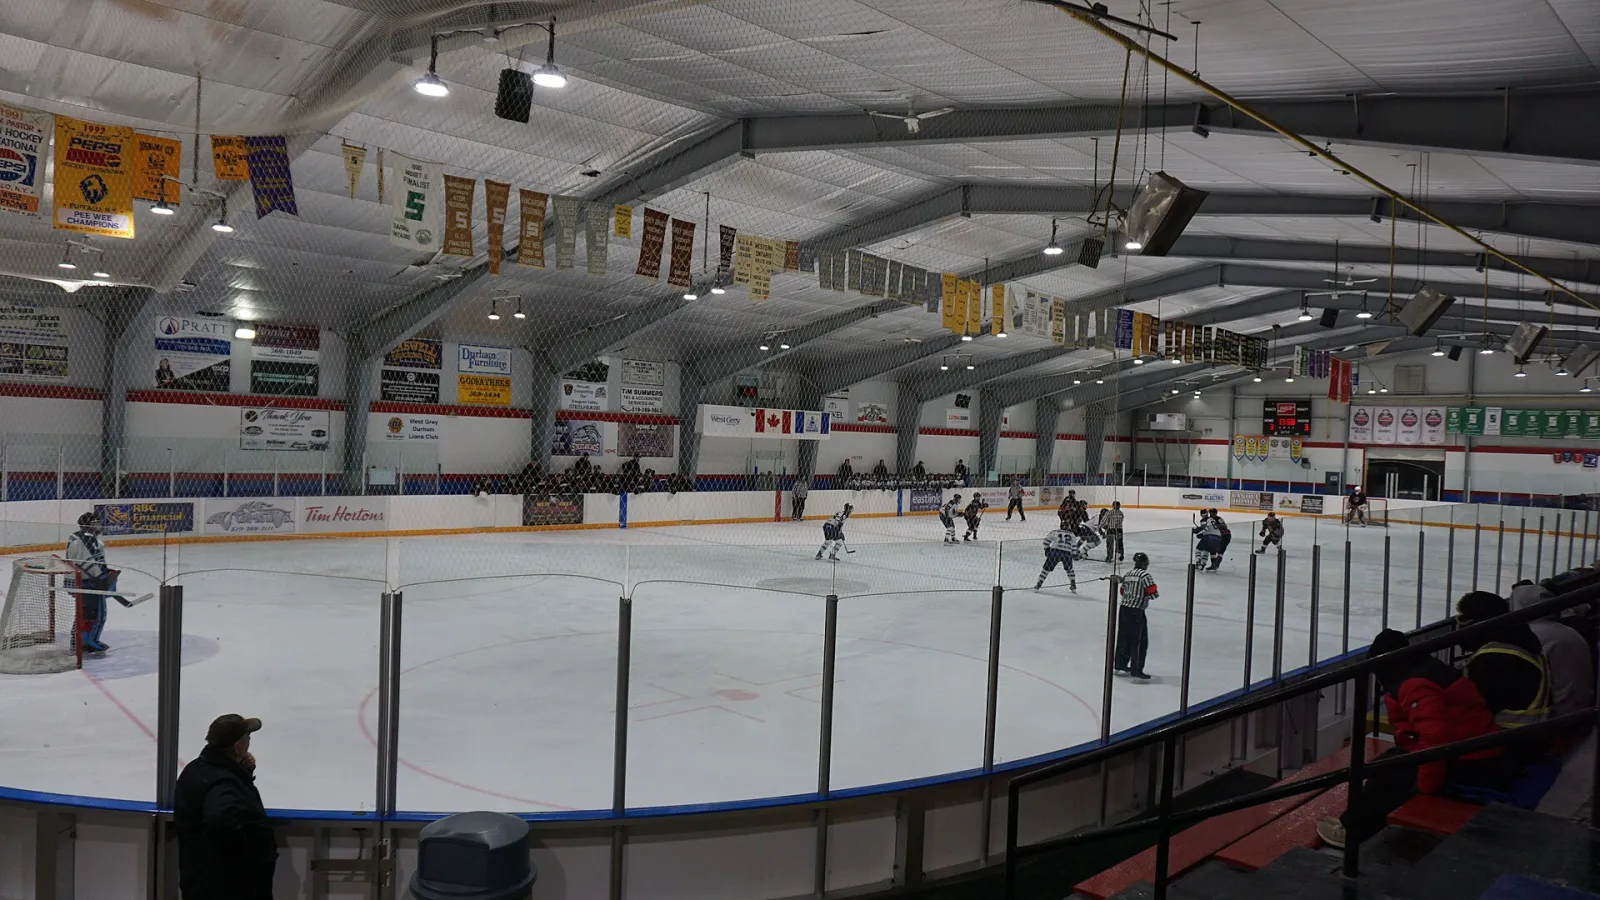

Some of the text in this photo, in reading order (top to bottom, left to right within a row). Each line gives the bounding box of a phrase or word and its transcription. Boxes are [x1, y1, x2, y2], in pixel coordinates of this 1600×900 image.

[6, 119, 34, 132] PASTOR
[83, 123, 106, 135] 1992
[5, 128, 43, 143] HOCKEY
[0, 137, 38, 153] ATIONAL
[69, 137, 122, 155] PEPSI
[403, 176, 430, 190] FINALIST
[74, 210, 112, 222] PEE WEE
[66, 217, 119, 229] CHAMPIONS
[181, 319, 229, 334] PRATT
[461, 347, 496, 360] Durham
[468, 357, 507, 369] Furniture
[633, 389, 663, 397] SUMMERS
[260, 409, 312, 424] Thank You
[710, 414, 741, 426] West Grey
[912, 493, 941, 503] eastlink
[133, 504, 156, 512] RBC
[305, 505, 384, 522] Tim Hortons
[132, 512, 182, 522] Financial
[132, 521, 167, 531] Group
[1058, 533, 1072, 545] 12
